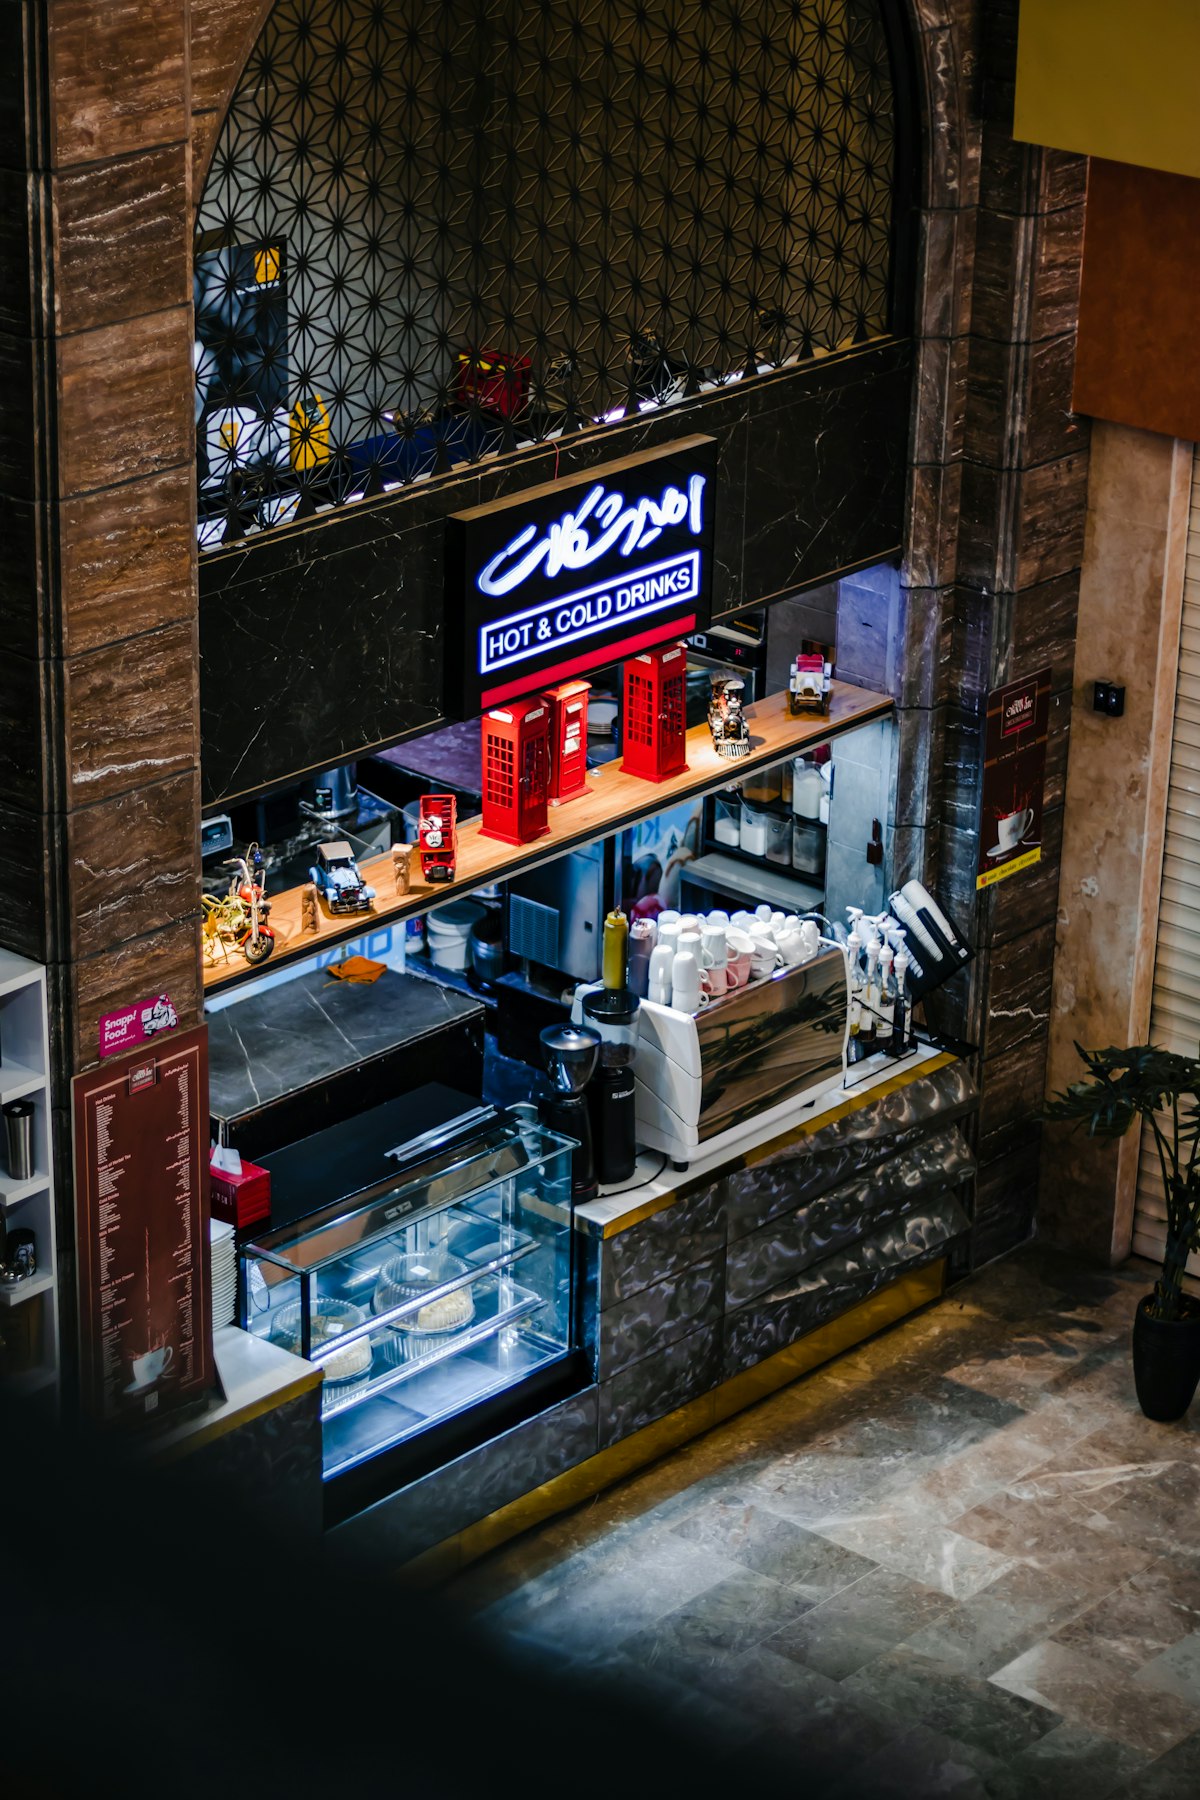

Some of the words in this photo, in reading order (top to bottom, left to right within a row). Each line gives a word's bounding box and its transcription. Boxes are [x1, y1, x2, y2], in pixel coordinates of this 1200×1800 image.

[488, 623, 533, 659] HOT
[536, 616, 552, 639] &
[556, 594, 612, 633] COLD
[616, 568, 691, 612] DRINKS
[105, 1010, 137, 1031] Snapp!
[104, 1024, 127, 1042] Food
